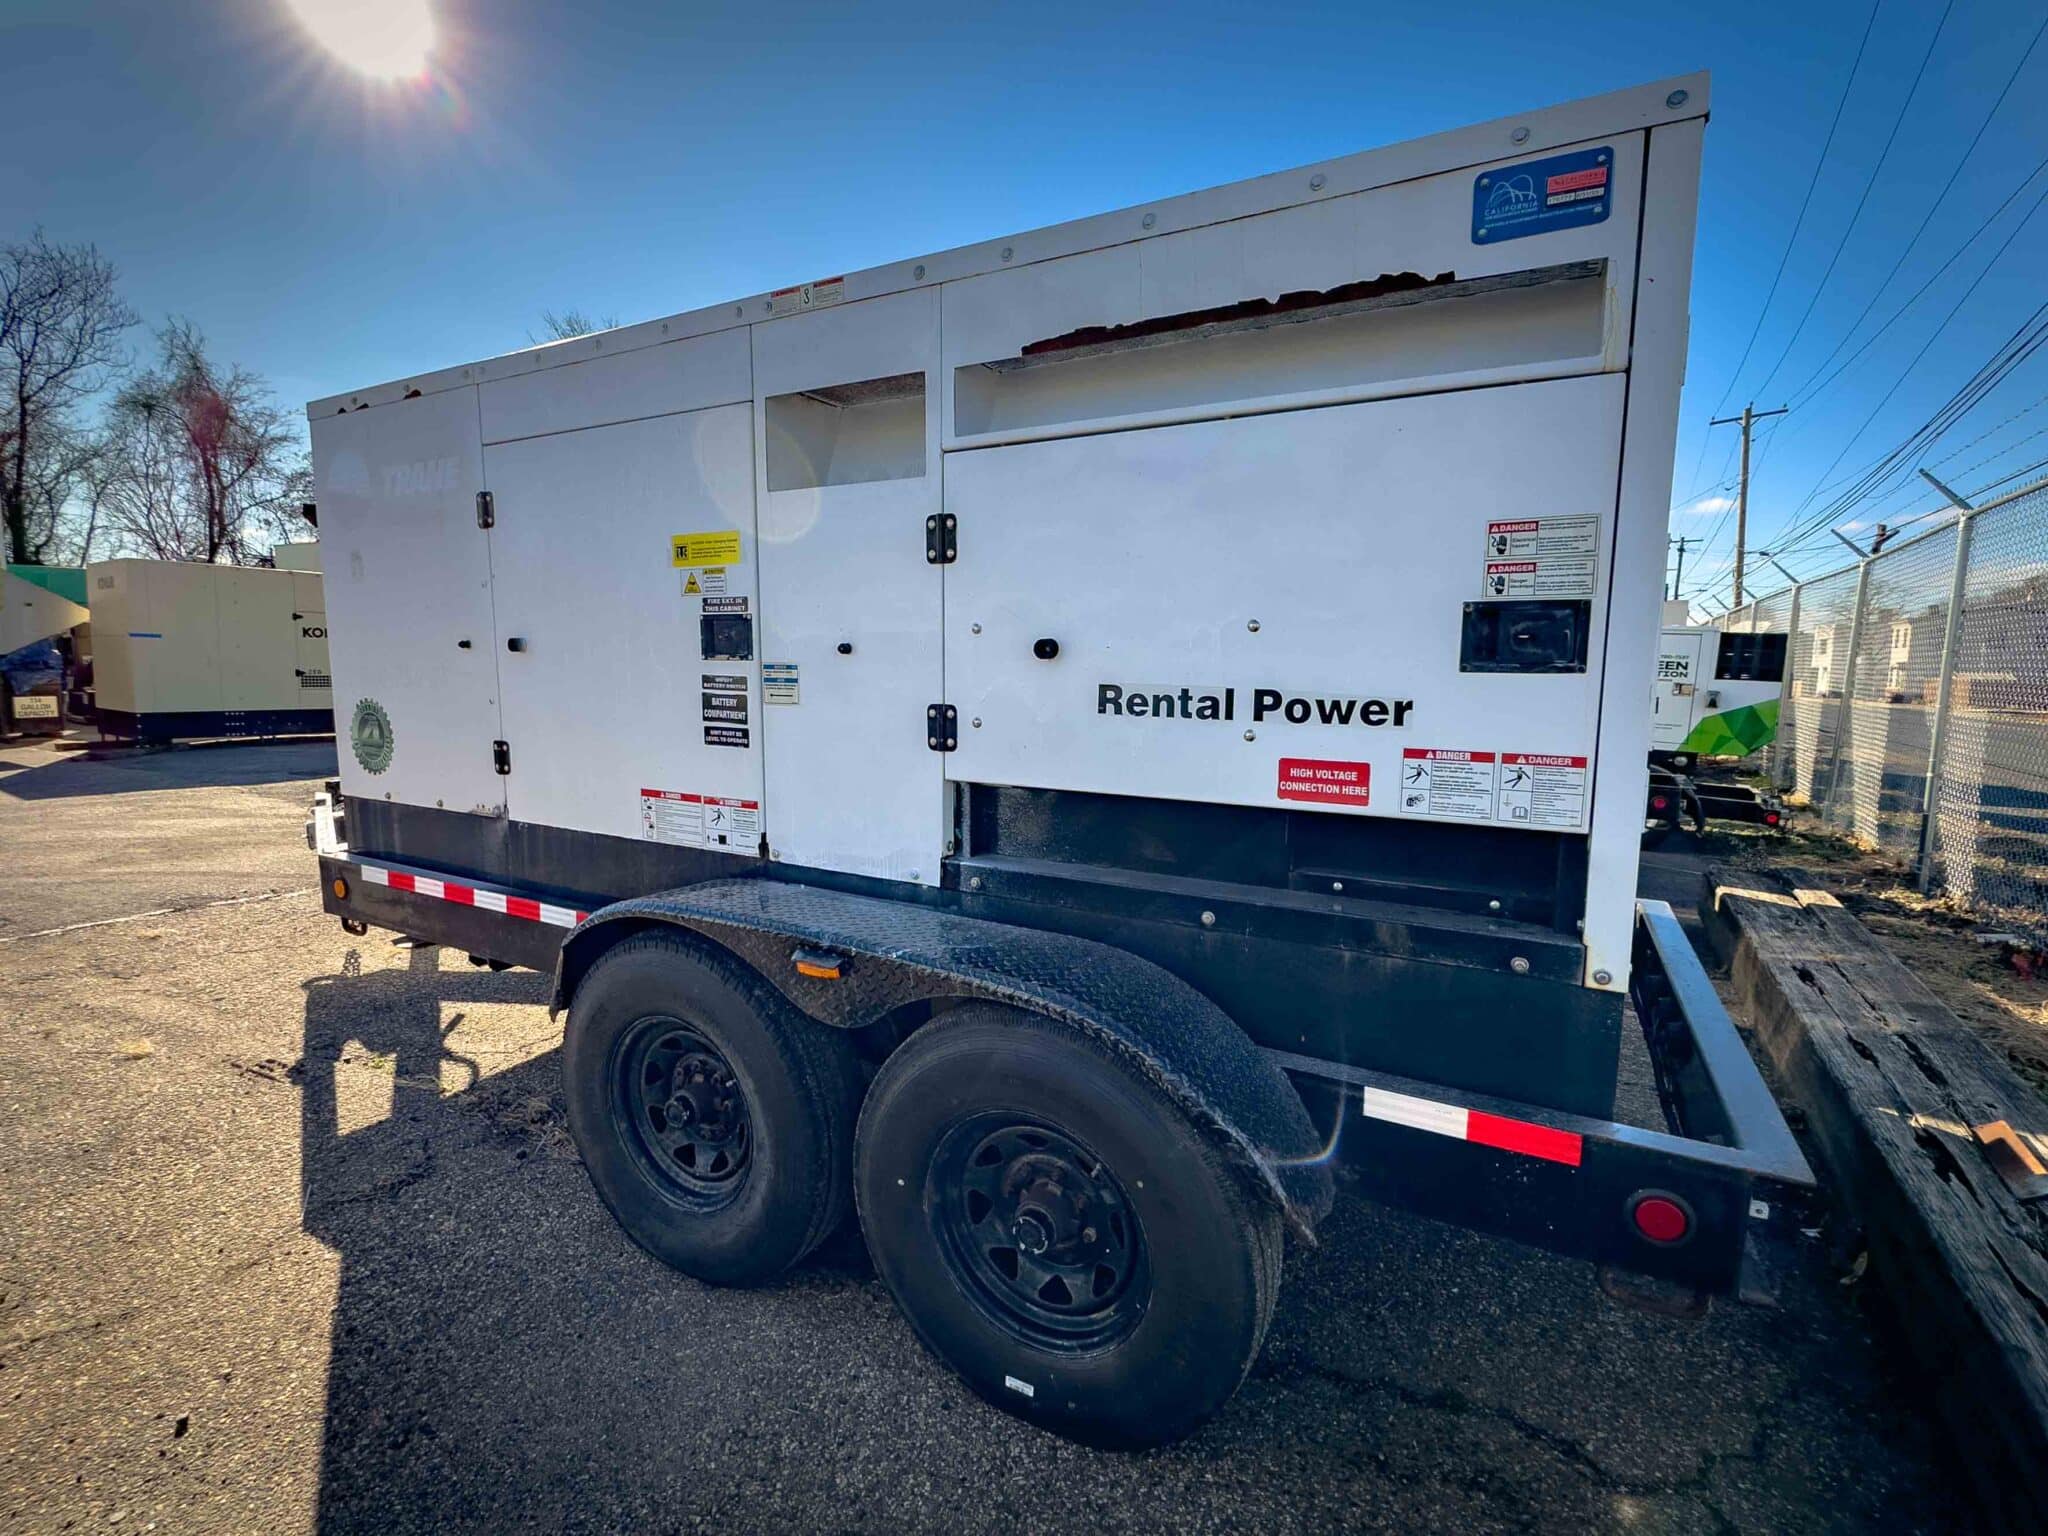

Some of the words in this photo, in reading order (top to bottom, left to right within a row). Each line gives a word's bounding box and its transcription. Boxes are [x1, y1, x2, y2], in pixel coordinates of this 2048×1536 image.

[1484, 201, 1539, 217] CALIFORNIA
[1500, 522, 1537, 532] DANGER
[1497, 564, 1534, 573] DANGER
[711, 697, 737, 707] BATTERY
[1097, 684, 1235, 721] Rental
[1253, 689, 1413, 727] Power
[703, 708, 746, 721] COMPARTMENT
[1435, 750, 1472, 761] DANGER
[1528, 756, 1573, 766] DANGER
[1290, 767, 1313, 778] HIGH
[1315, 769, 1359, 781] VOLTAGE
[1279, 781, 1340, 795] CONNECTION
[1341, 785, 1369, 797] HERE
